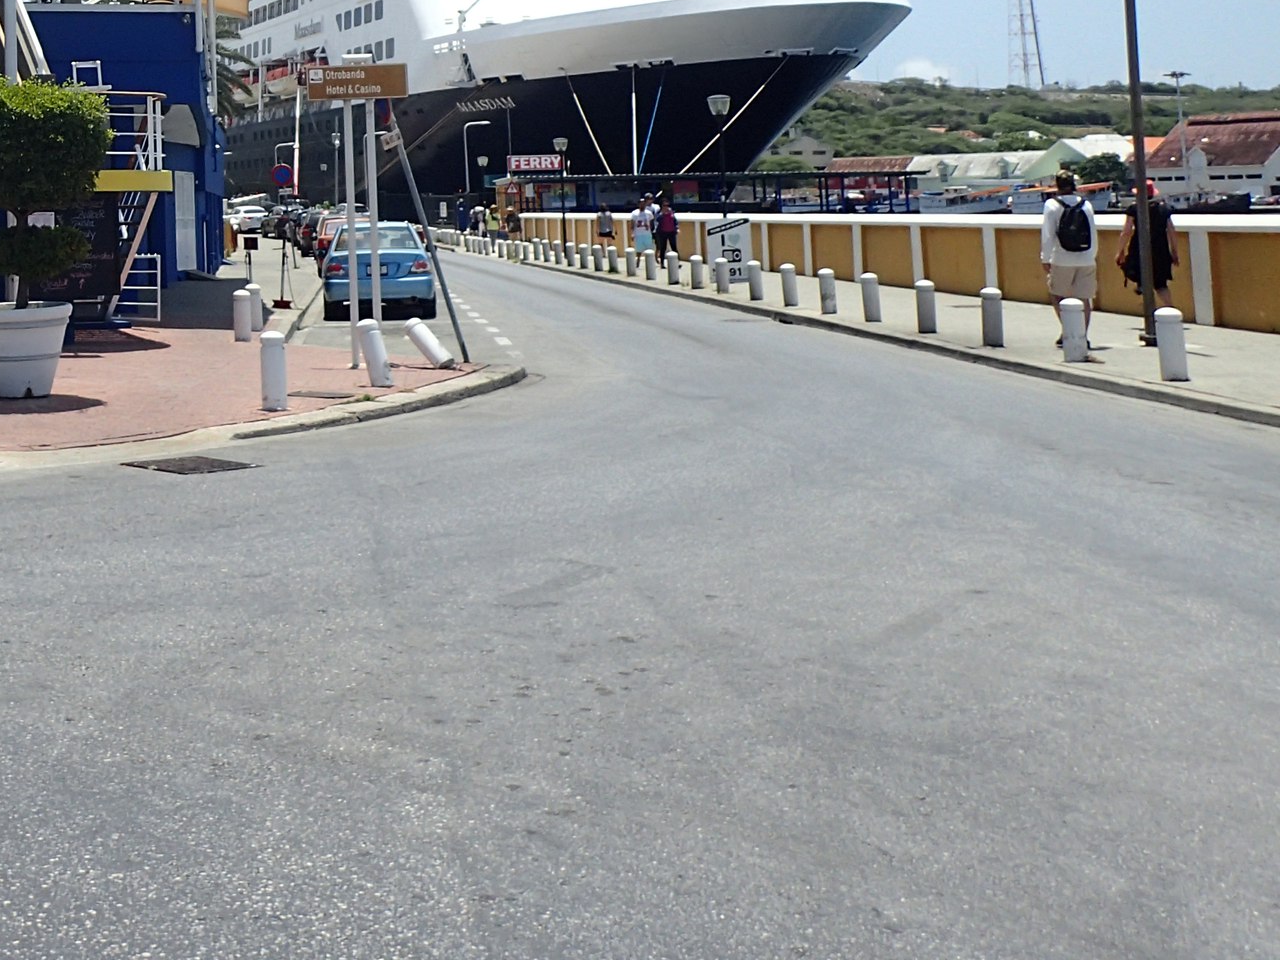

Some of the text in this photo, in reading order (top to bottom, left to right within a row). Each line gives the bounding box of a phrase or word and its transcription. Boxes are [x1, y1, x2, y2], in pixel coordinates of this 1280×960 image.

[325, 69, 366, 80] Otrobanda
[326, 84, 382, 95] Hotel & Casino
[456, 96, 516, 112] MAASDAM
[511, 155, 561, 169] FERRY
[729, 267, 742, 277] 91
